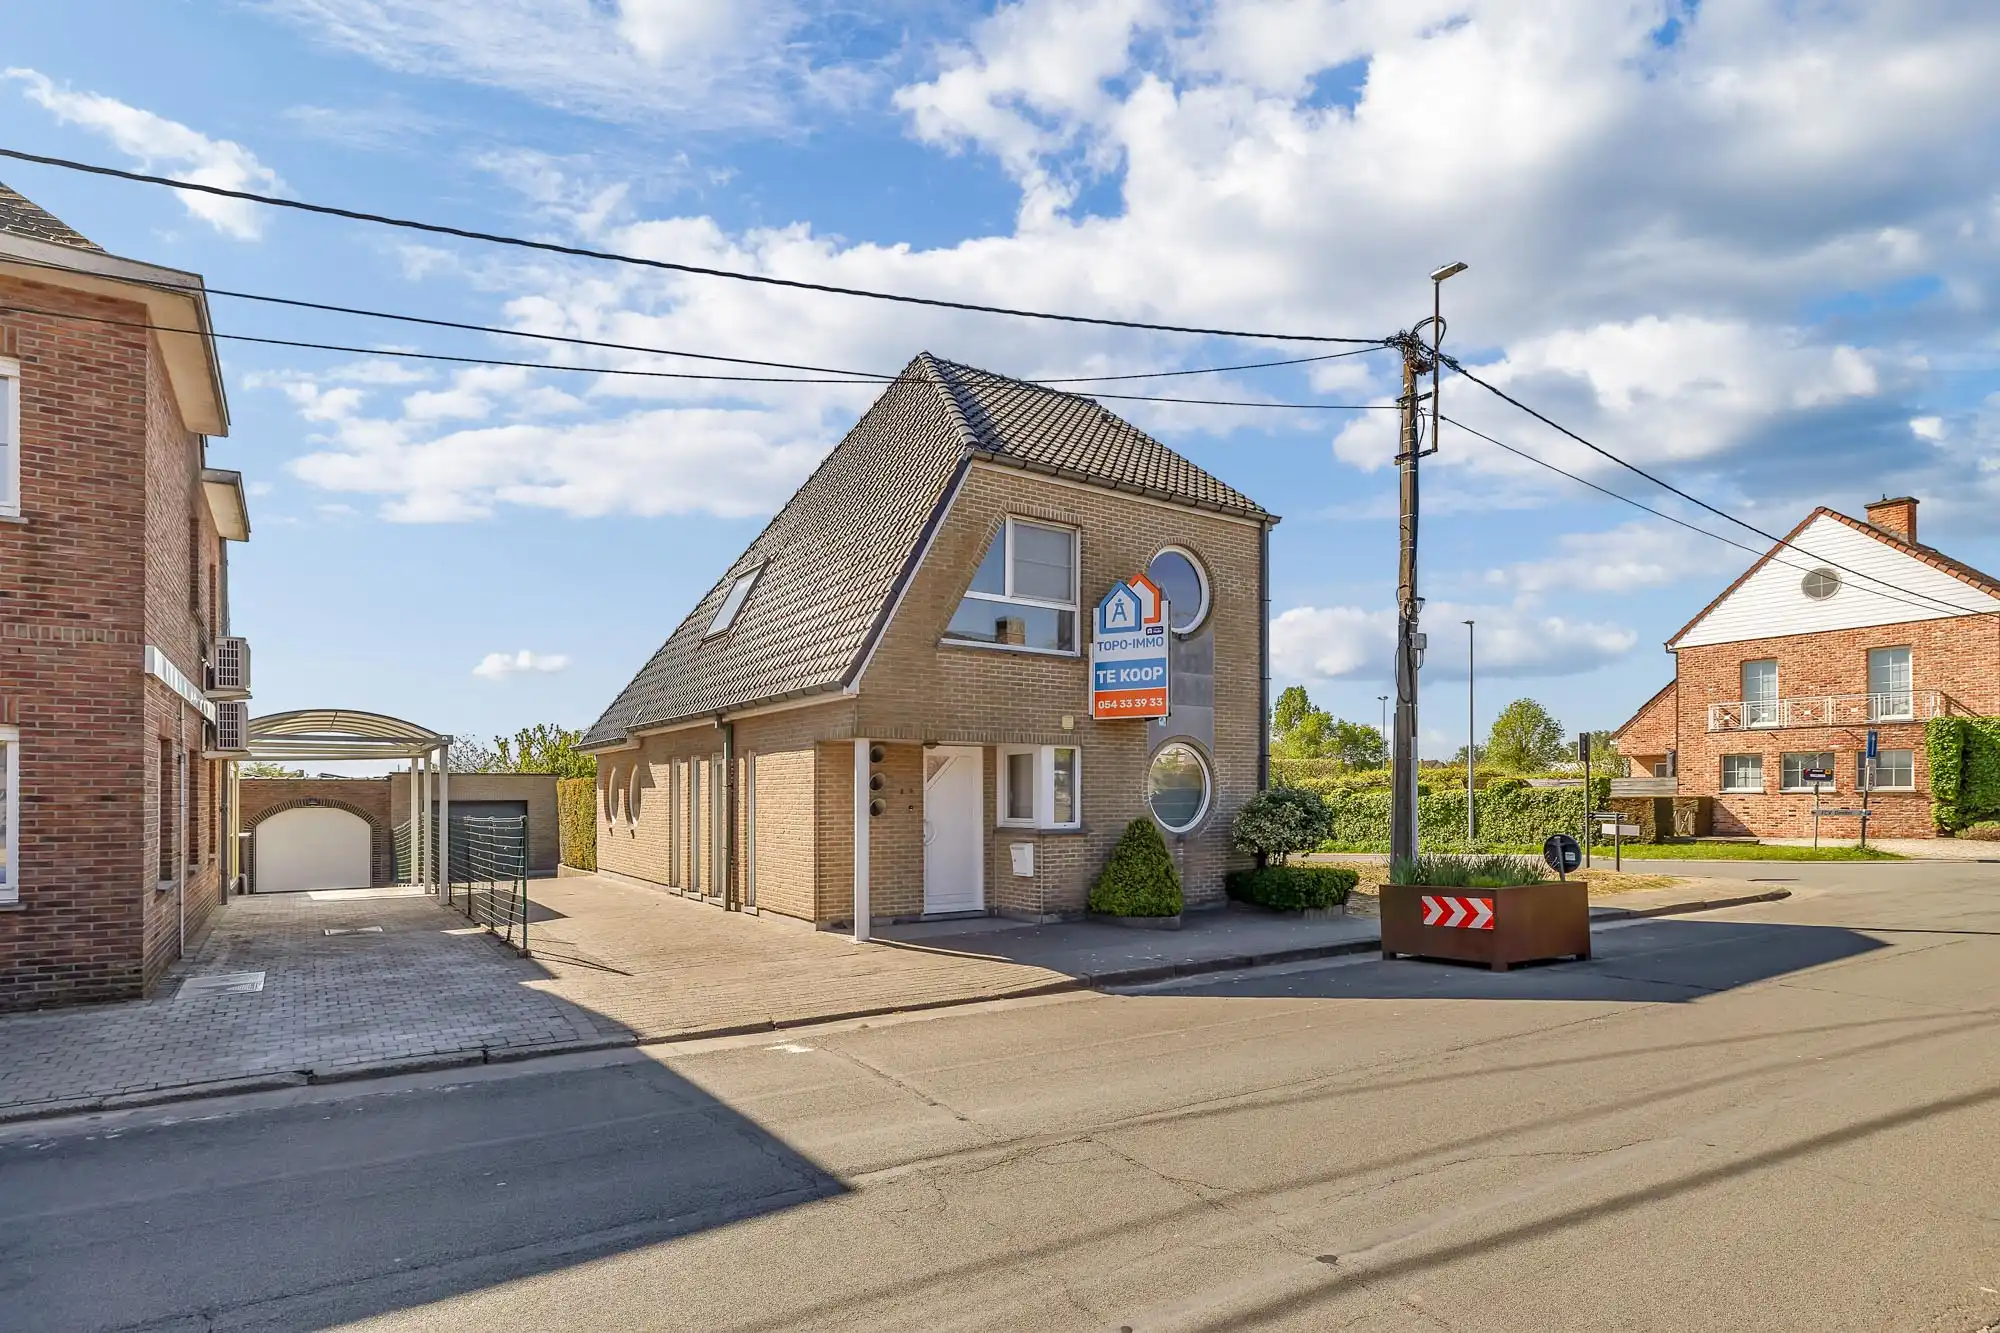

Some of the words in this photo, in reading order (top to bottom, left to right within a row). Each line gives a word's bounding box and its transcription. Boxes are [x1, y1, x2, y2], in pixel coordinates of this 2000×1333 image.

[1097, 637, 1164, 652] TOPO-IMMO
[1096, 669, 1117, 684] TE
[1120, 666, 1164, 683] KOOP
[1098, 700, 1118, 710] 054
[1119, 699, 1133, 709] 33
[1134, 698, 1148, 708] 39
[1149, 697, 1163, 707] 33
